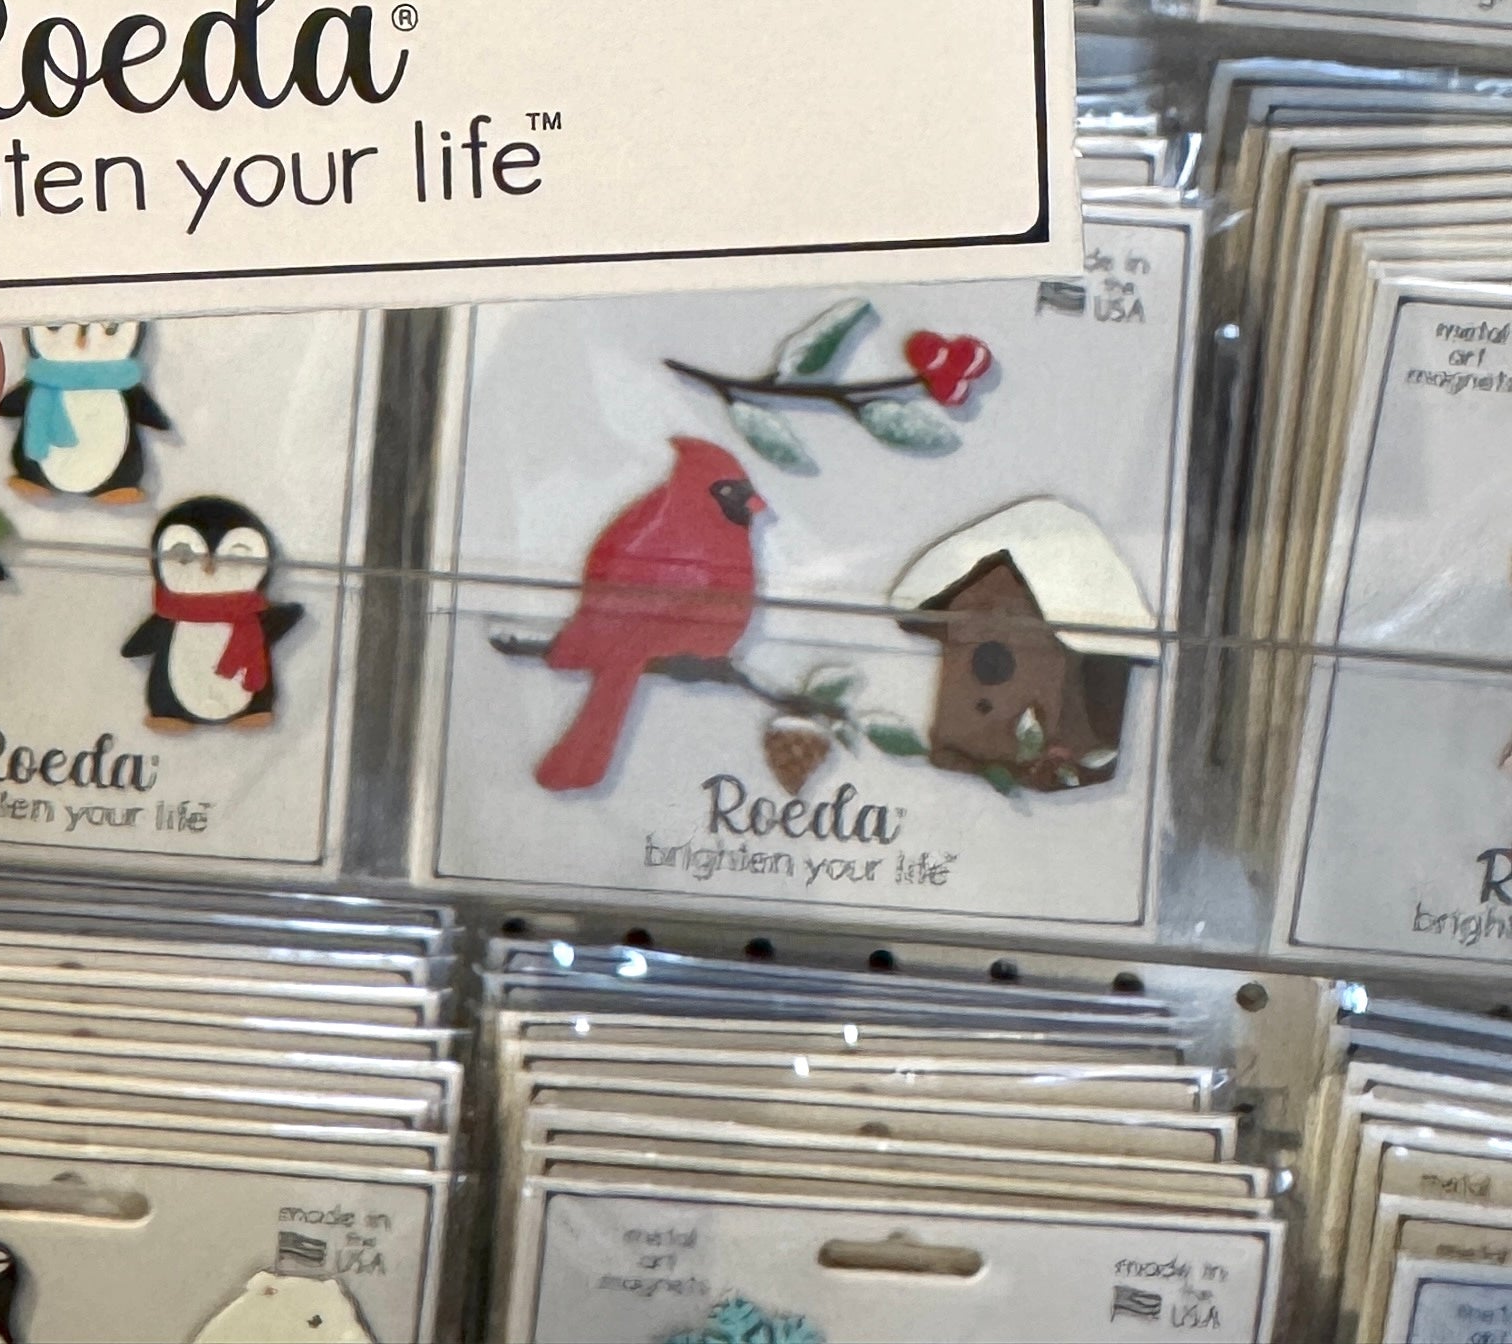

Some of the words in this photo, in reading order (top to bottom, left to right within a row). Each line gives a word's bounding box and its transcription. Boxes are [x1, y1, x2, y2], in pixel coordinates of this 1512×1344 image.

[176, 146, 378, 235] your
[65, 803, 144, 833] your
[805, 857, 885, 887] your
